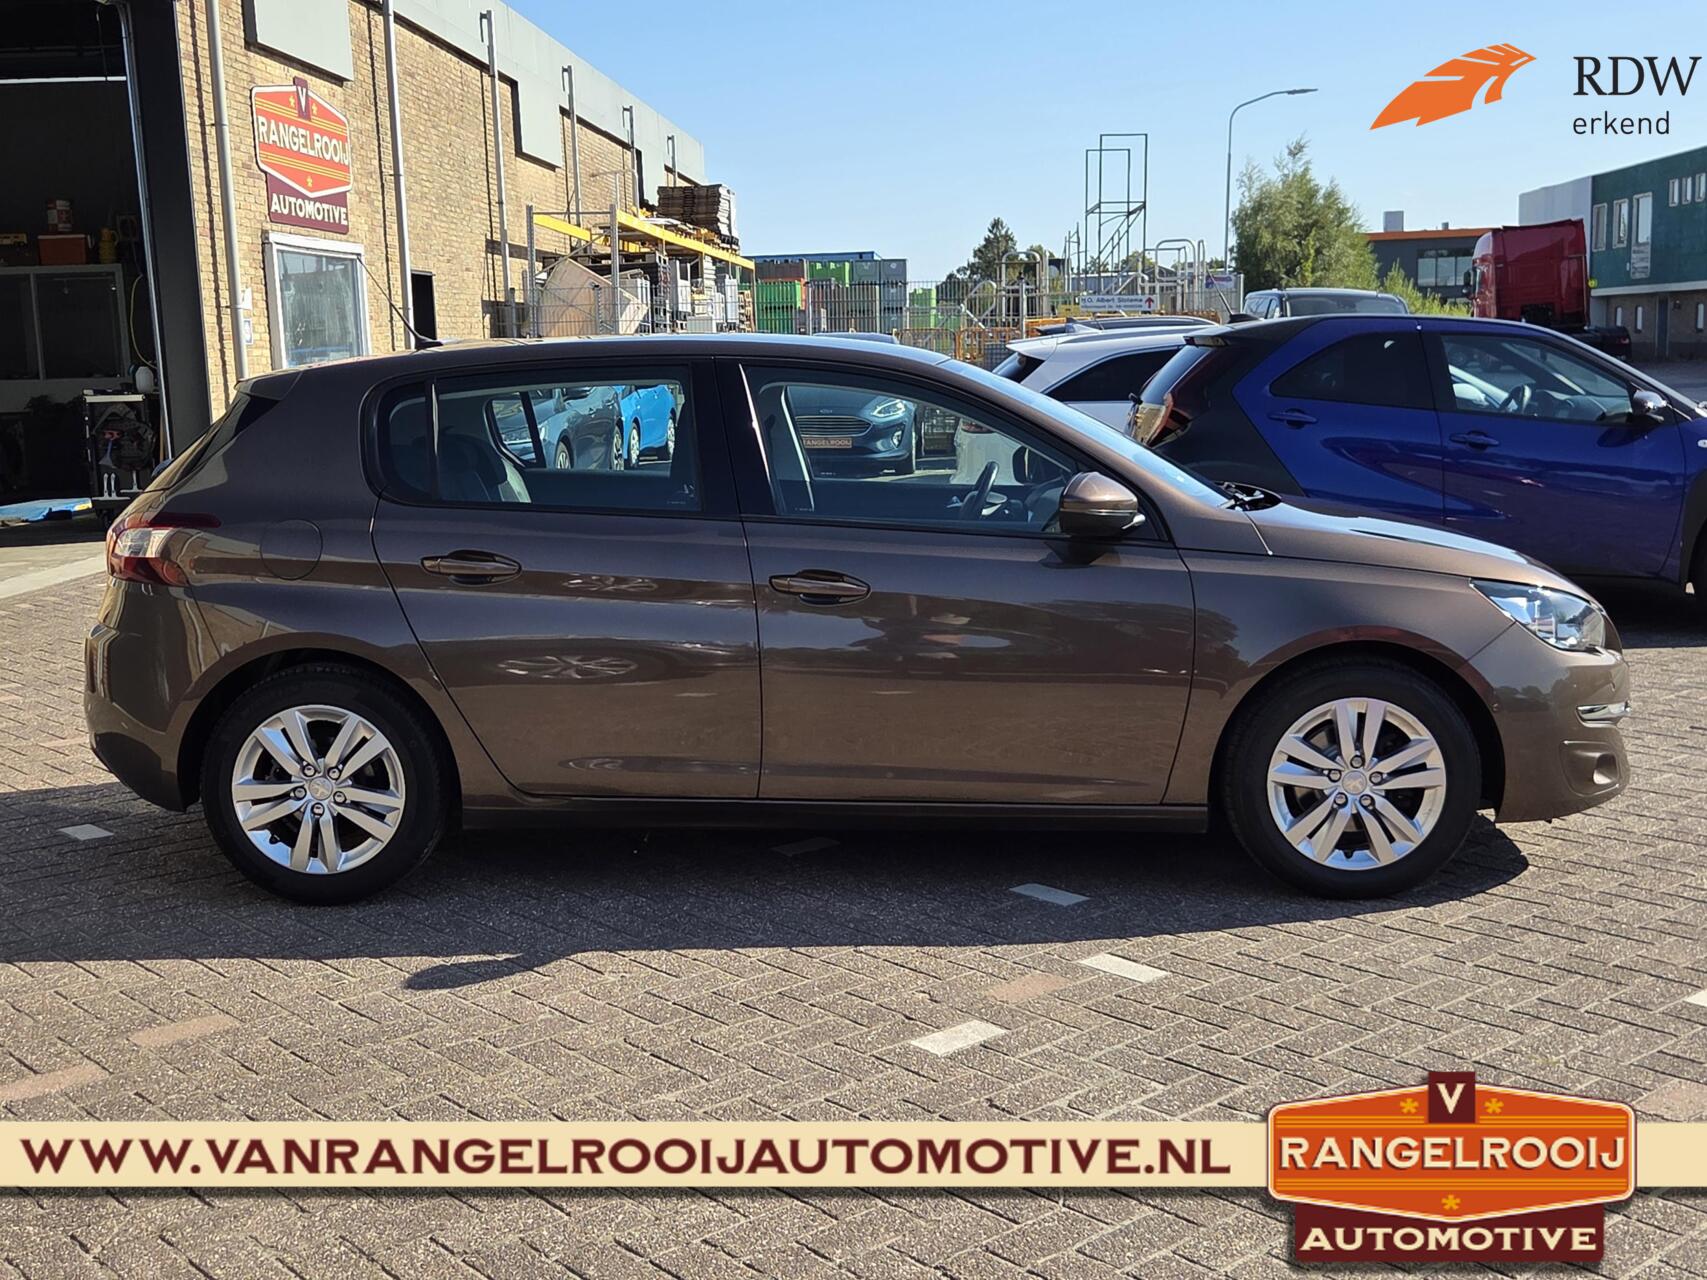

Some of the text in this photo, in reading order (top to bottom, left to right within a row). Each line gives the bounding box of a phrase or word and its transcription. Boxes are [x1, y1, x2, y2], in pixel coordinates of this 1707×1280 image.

[297, 86, 306, 112] V
[257, 116, 350, 165] RANGELROOIJ
[271, 194, 348, 225] AUTOMOTIVE
